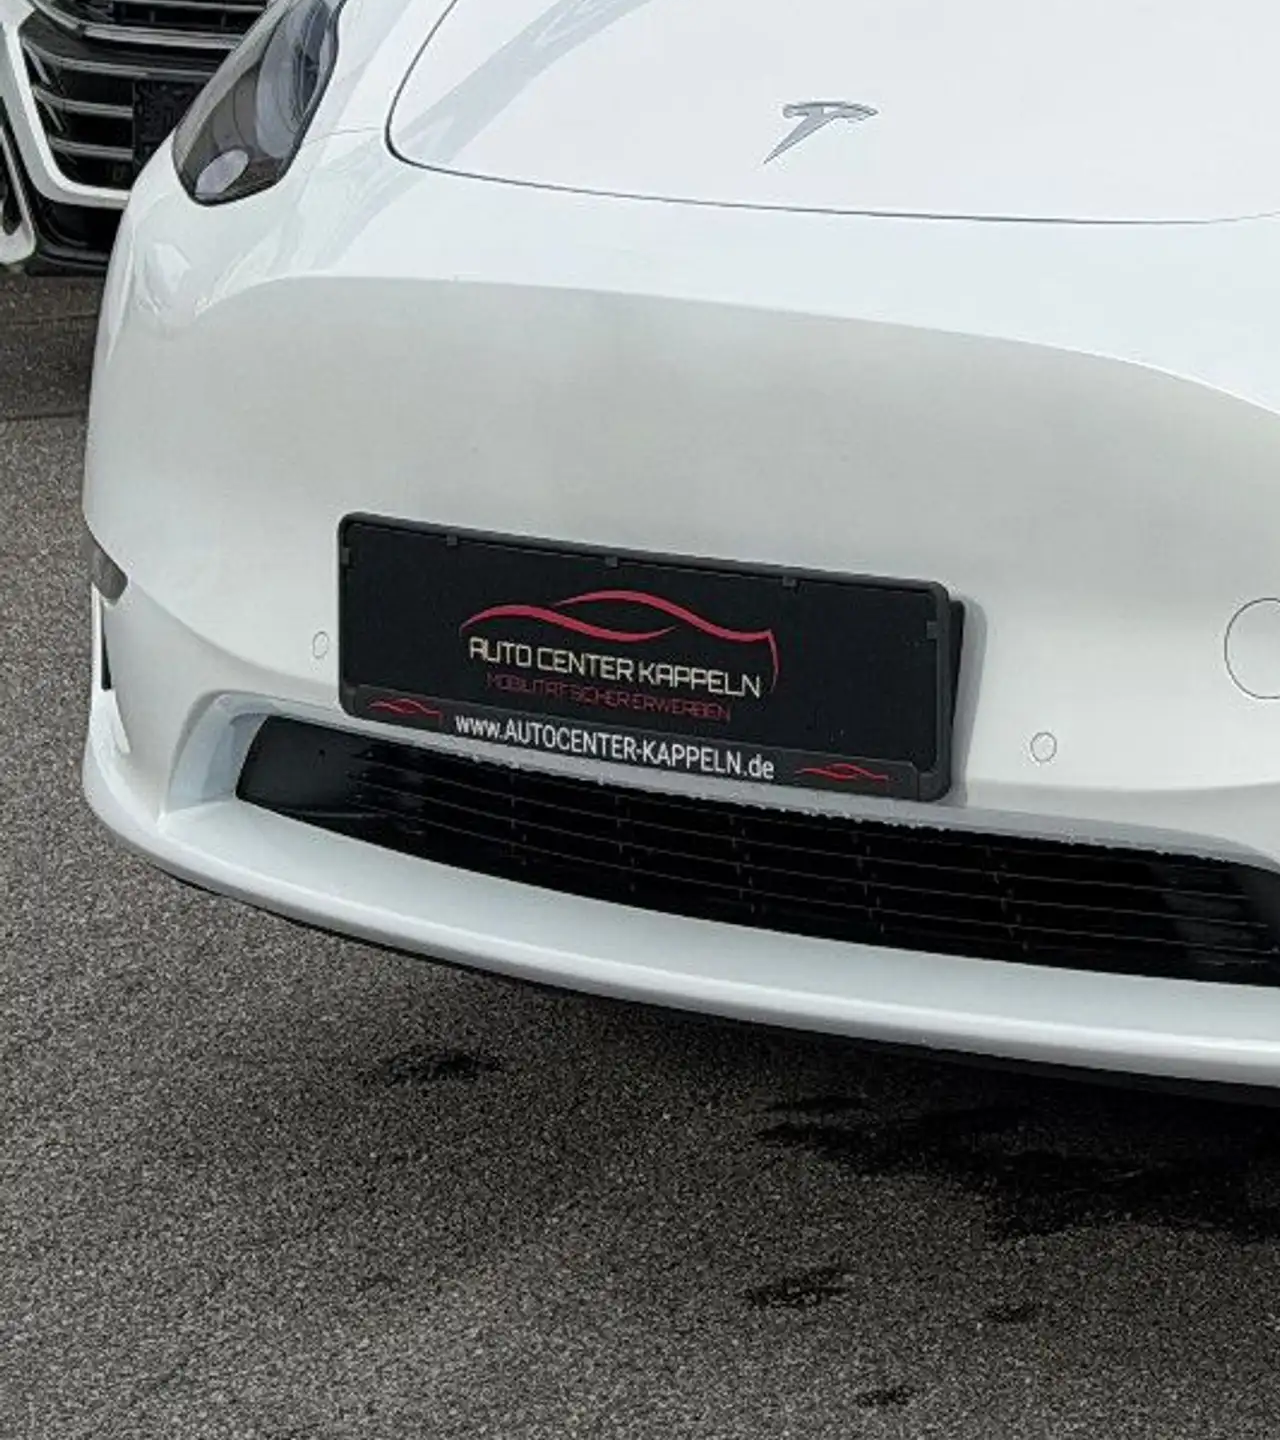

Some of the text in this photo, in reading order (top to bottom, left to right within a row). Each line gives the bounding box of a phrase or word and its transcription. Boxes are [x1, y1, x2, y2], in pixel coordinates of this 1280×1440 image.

[469, 636, 761, 700] AUTO CENTER KAPPELN
[455, 715, 776, 780] www.AUTOCENTER-KAPPELN.de
